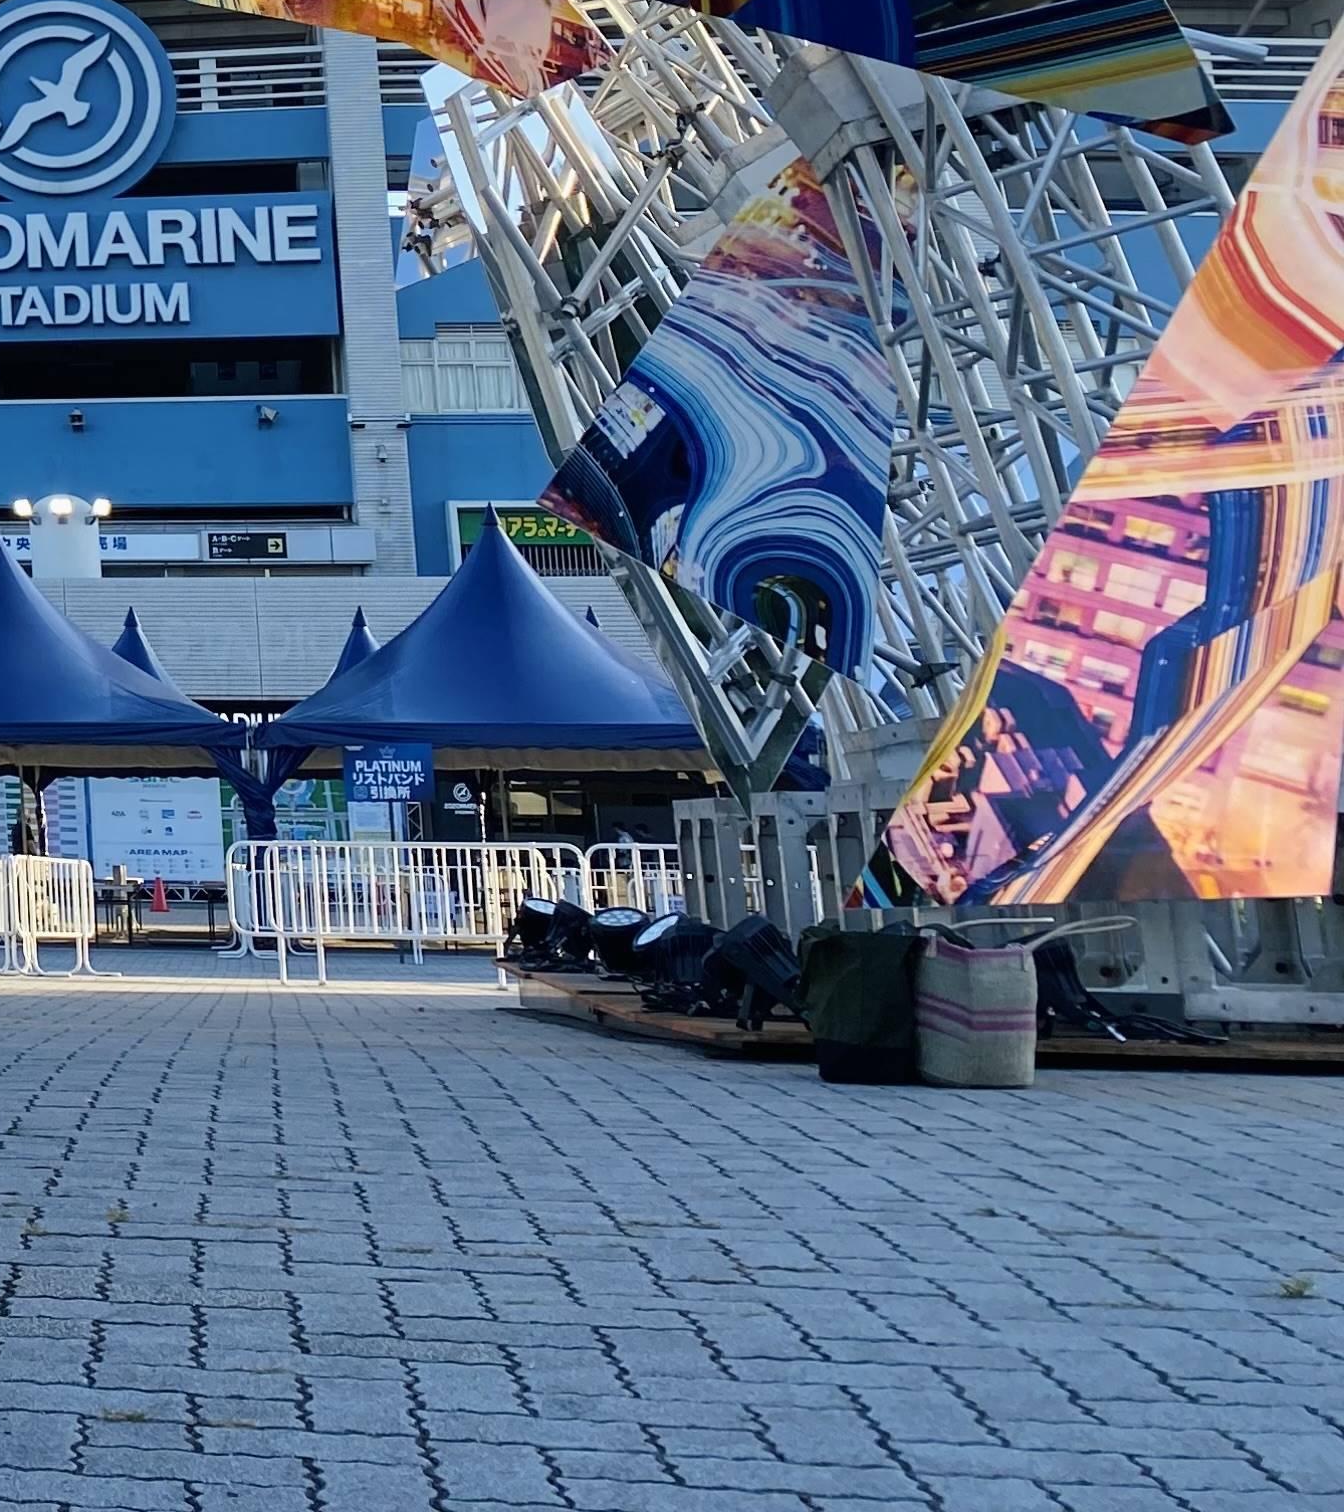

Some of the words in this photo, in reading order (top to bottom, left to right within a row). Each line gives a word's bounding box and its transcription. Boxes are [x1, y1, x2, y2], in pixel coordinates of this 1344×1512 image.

[354, 759, 422, 773] PLATINUM
[352, 773, 425, 786] リストバンド
[370, 785, 411, 800] 引換所
